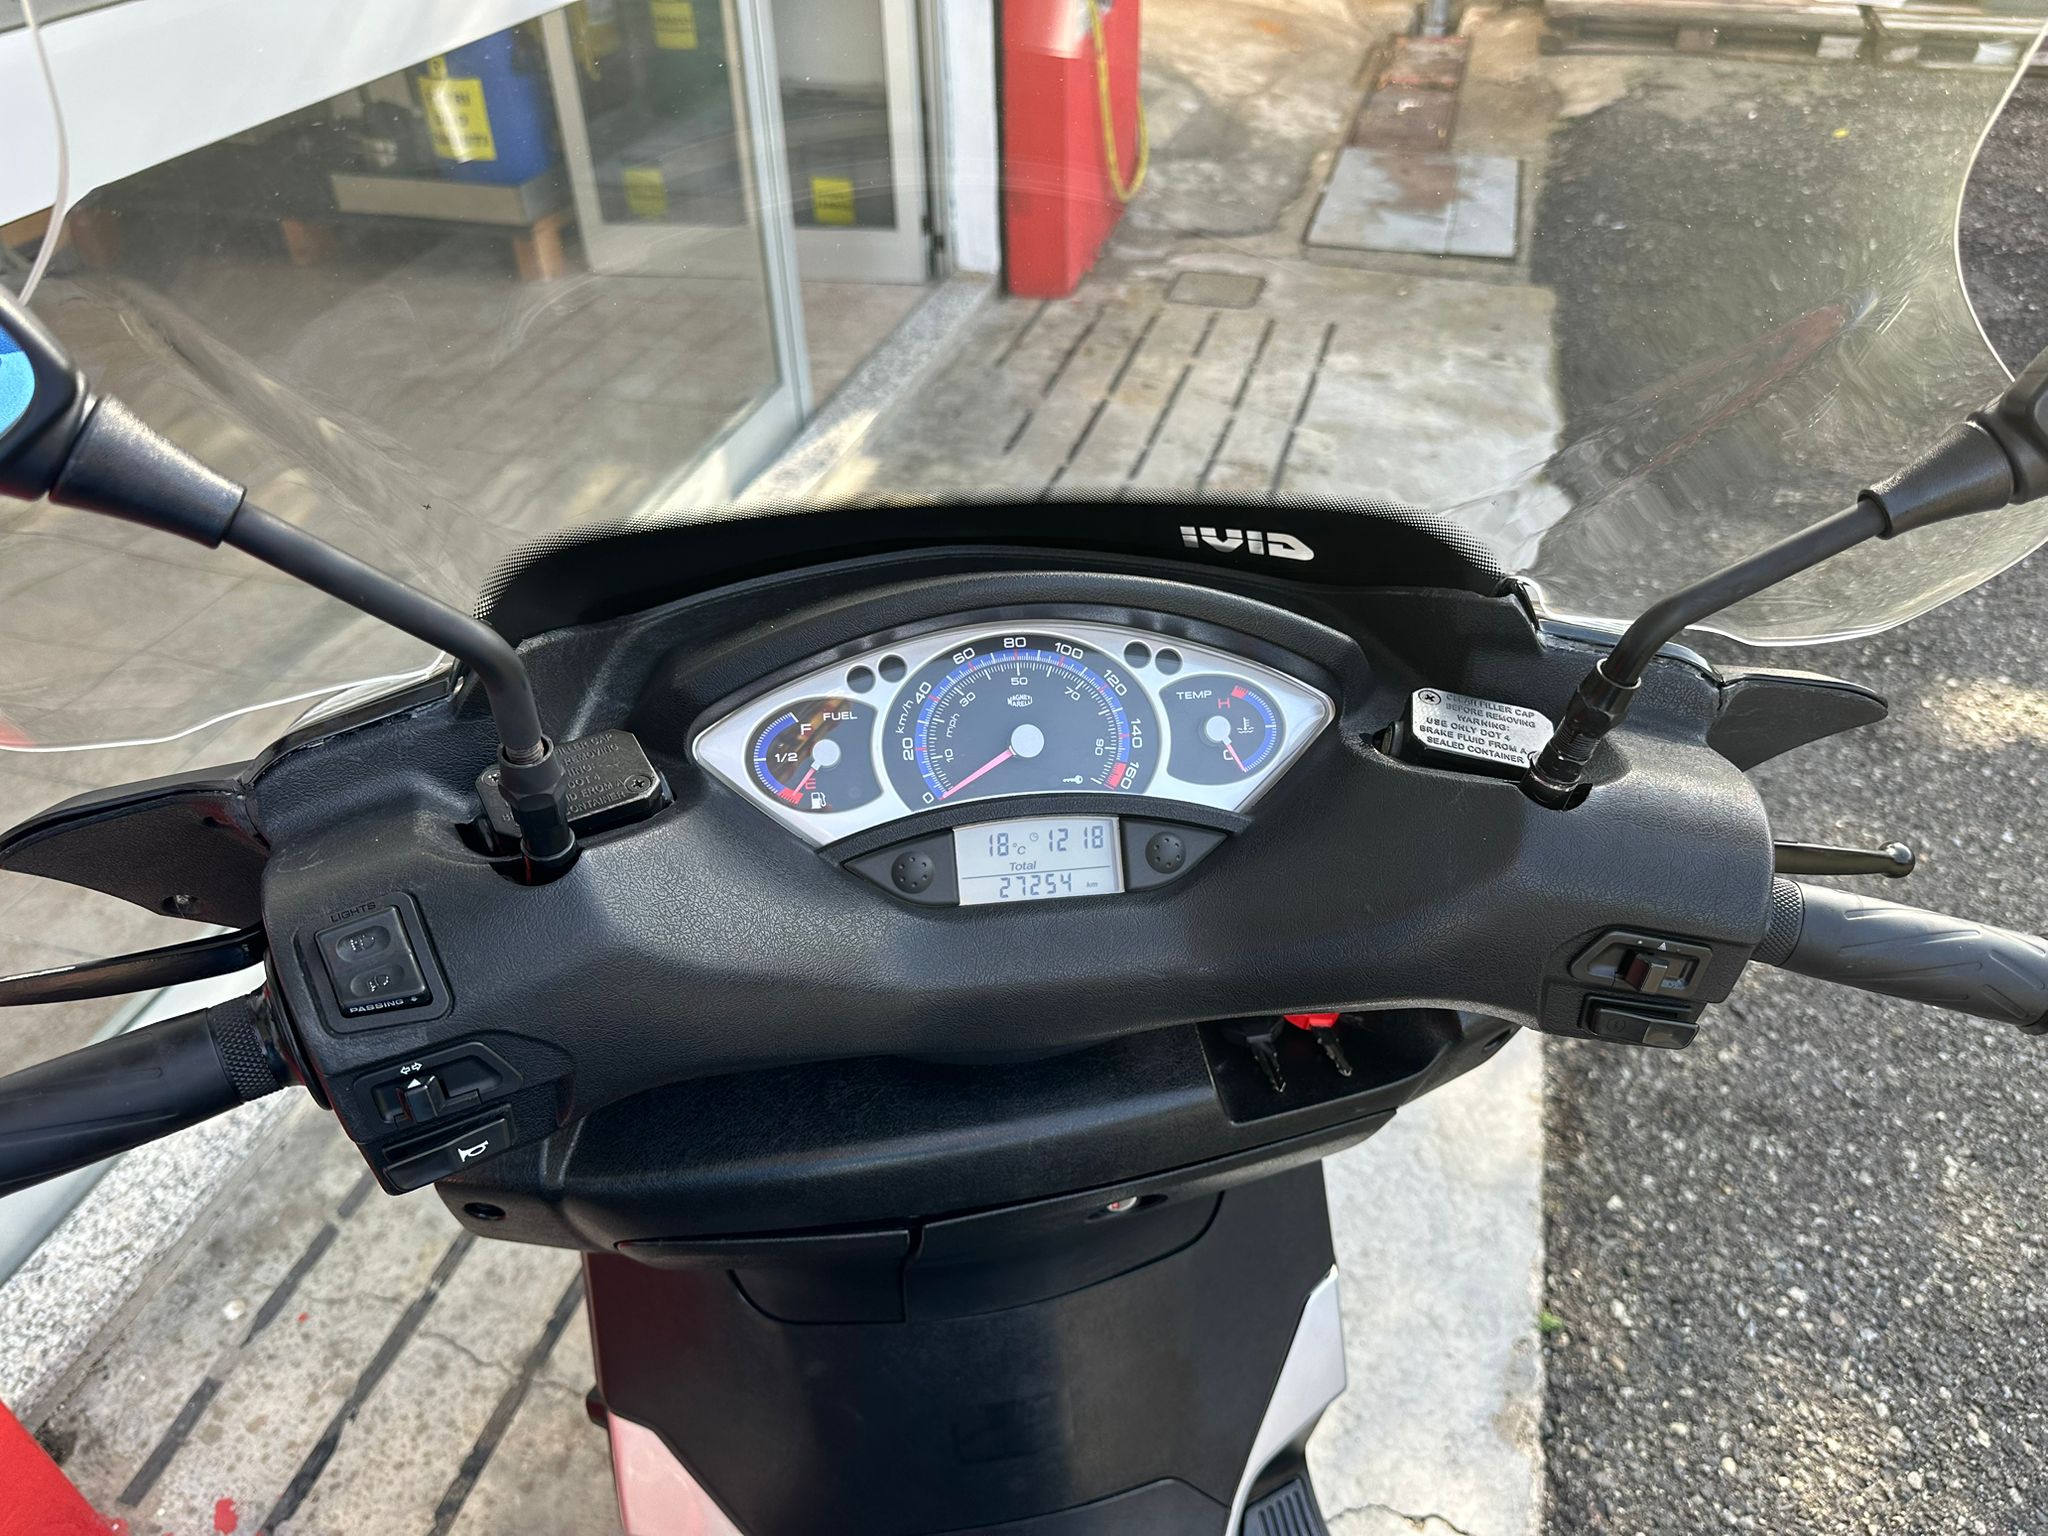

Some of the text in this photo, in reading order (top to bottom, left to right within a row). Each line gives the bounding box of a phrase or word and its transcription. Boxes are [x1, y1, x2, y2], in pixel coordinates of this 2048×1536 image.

[1003, 637, 1027, 649] 80
[1054, 642, 1084, 660] 100
[953, 647, 976, 665] 60
[1010, 677, 1028, 686] 50
[1103, 669, 1128, 697] 120
[915, 681, 932, 705] 40
[959, 692, 976, 707] 30
[1064, 686, 1081, 701] 70
[1176, 690, 1212, 700] TEMP
[1218, 698, 1231, 709] H
[1479, 701, 1513, 715] FILLER
[1515, 709, 1535, 718] CAP
[823, 711, 858, 721] FUEL
[895, 699, 914, 734] km/h
[1446, 703, 1536, 728] BEFORE REMOVING
[1457, 714, 1510, 732] WARNING:
[800, 723, 812, 735] F
[946, 712, 960, 738] mph
[1130, 718, 1143, 749] 140
[1426, 717, 1448, 728] USE
[1450, 722, 1477, 734] ONLY
[1480, 729, 1502, 739] DOT
[903, 737, 915, 761] 20
[1095, 738, 1104, 756] 90
[1419, 725, 1528, 755] BRAKE FLUID FROM A
[774, 752, 798, 763] 1/2
[944, 748, 954, 763] 10
[1426, 736, 1525, 764] SEALED CONTAINER
[805, 779, 817, 790] E
[1120, 761, 1140, 790] 160
[922, 792, 934, 804] 0
[1009, 860, 1037, 872] Total
[1000, 872, 1072, 898] 27254
[330, 901, 377, 923] LIGHTS
[349, 998, 404, 1014] PASSING
